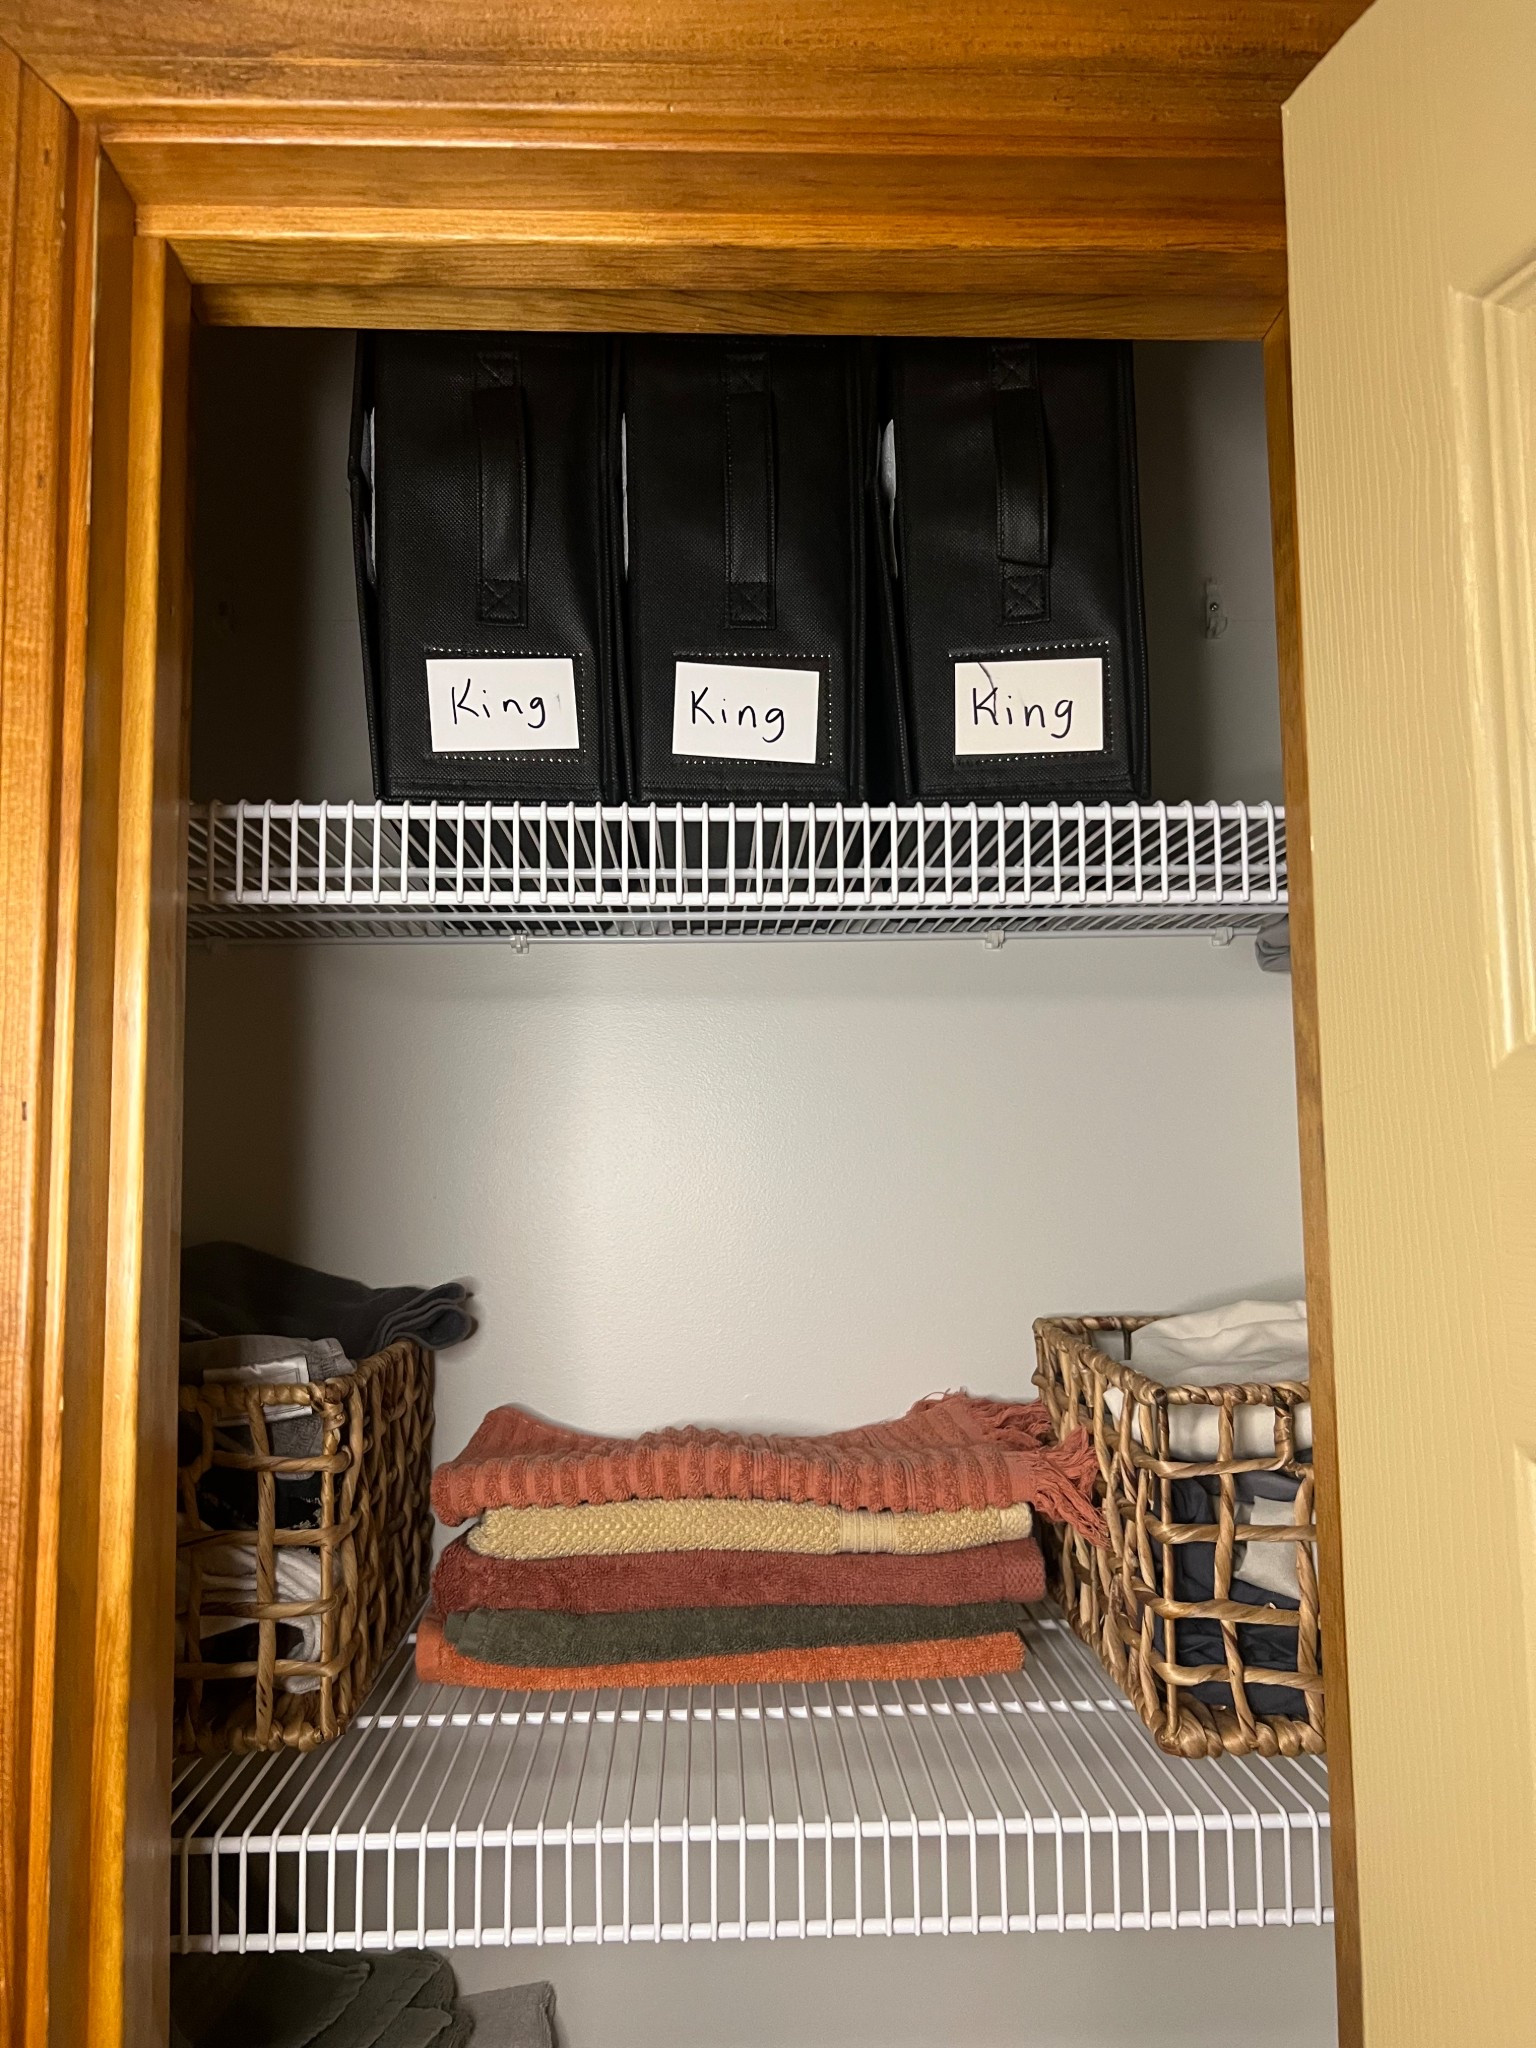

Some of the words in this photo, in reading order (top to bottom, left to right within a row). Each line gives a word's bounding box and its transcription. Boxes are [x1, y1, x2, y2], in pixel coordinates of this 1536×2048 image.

[451, 678, 546, 729] King
[691, 686, 785, 743] King
[972, 682, 1073, 739] King
